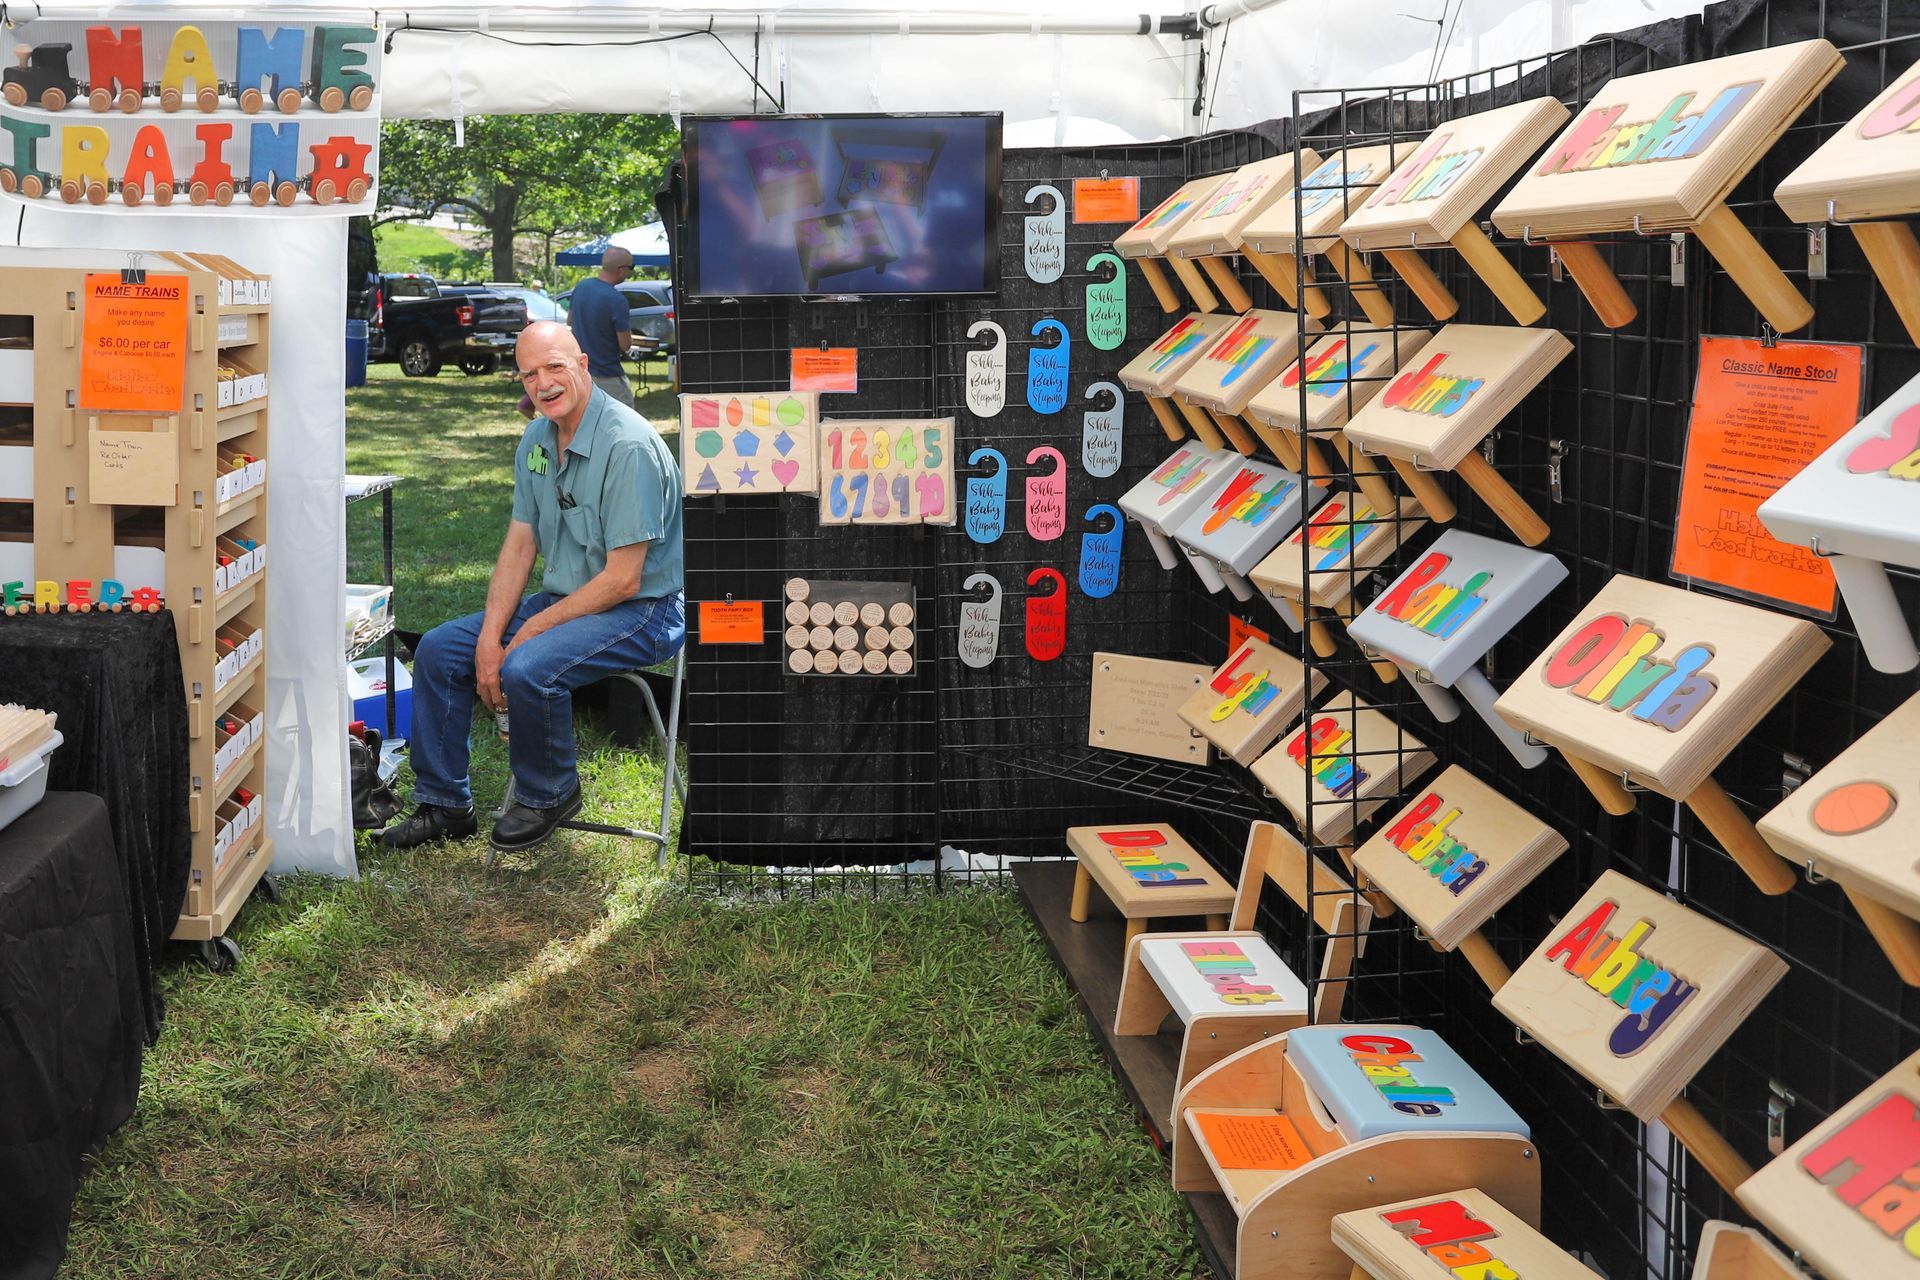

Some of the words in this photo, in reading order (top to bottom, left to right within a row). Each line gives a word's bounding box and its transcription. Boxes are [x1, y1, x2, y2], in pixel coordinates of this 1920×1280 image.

[85, 25, 378, 112] NAME
[0, 115, 300, 206] TRAIN
[1367, 132, 1485, 209] Anna
[1029, 238, 1060, 259] Baby
[1030, 256, 1061, 276] Sleeping
[95, 286, 131, 296] NAME
[135, 287, 180, 297] TRAINS
[129, 310, 142, 318] any
[132, 318, 154, 326] desire
[1091, 307, 1121, 324] Baby
[99, 337, 129, 348] $6.00
[132, 340, 151, 350] per
[153, 340, 170, 349] car
[1092, 324, 1123, 343] Sleeping
[1722, 358, 1765, 373] Classic
[1767, 362, 1801, 376] Name
[1804, 365, 1838, 380] Stool
[970, 370, 1001, 391] Baby
[1032, 371, 1062, 392] Baby
[1381, 351, 1485, 418] James
[971, 388, 1001, 408] Sleeping
[1032, 388, 1062, 408] Sleeping
[828, 428, 842, 470] 1
[849, 428, 868, 469] 2
[872, 428, 890, 469] 3
[895, 427, 917, 469] 4
[923, 428, 943, 468] 5
[1087, 433, 1117, 452] Baby
[1087, 451, 1118, 469] Sleeping
[830, 472, 848, 518] 6
[849, 472, 869, 518] 7
[871, 472, 890, 518] 8
[891, 473, 910, 518] 9
[915, 472, 945, 517] 10
[1202, 468, 1298, 536] Wyatt
[969, 500, 1001, 520] Baby
[1030, 498, 1061, 517] Baby
[970, 516, 1000, 537] Sleeping
[1031, 515, 1062, 535] Sleeping
[1693, 525, 1823, 575] Woodworks
[1084, 556, 1115, 576] Baby
[1084, 571, 1114, 592] Sleeping
[2, 578, 125, 615] FRED
[963, 624, 995, 644] Baby
[963, 640, 993, 661] Sleeping
[1542, 613, 1720, 734] Olivia
[1210, 647, 1283, 723] Logan
[1384, 791, 1490, 898] Rebecca
[1096, 830, 1208, 889] Daniel
[1544, 899, 1701, 1060] Aubrey
[1339, 1034, 1457, 1117] Charlie
